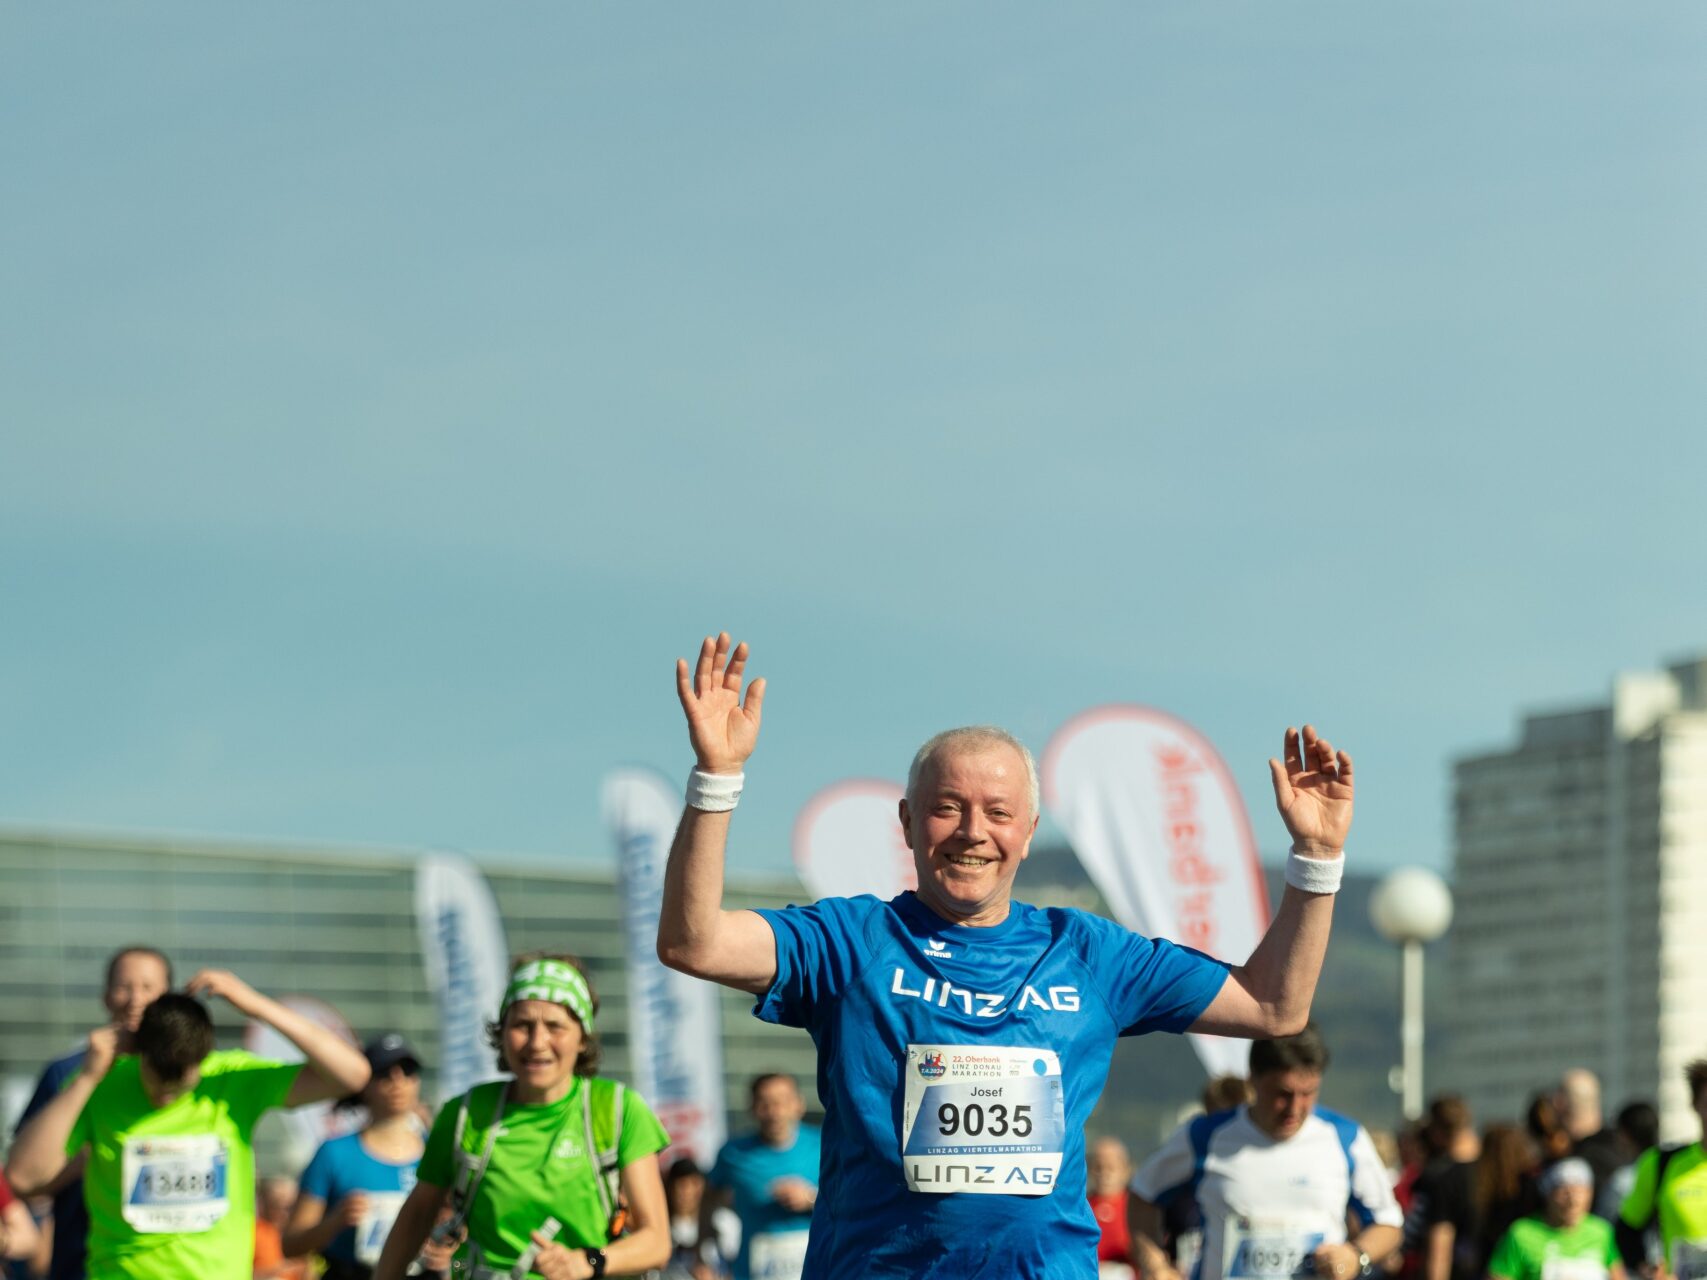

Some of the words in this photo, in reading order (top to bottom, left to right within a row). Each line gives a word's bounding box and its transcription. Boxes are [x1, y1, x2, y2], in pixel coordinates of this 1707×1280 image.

[891, 968, 1006, 1018] LINZ
[1017, 985, 1080, 1012] AG
[952, 1055, 964, 1063] 22.
[965, 1055, 1001, 1063] Oberbank
[970, 1087, 1004, 1097] Josef
[938, 1103, 1033, 1138] 9035
[913, 1164, 995, 1185] LINZ
[1004, 1167, 1053, 1185] AG
